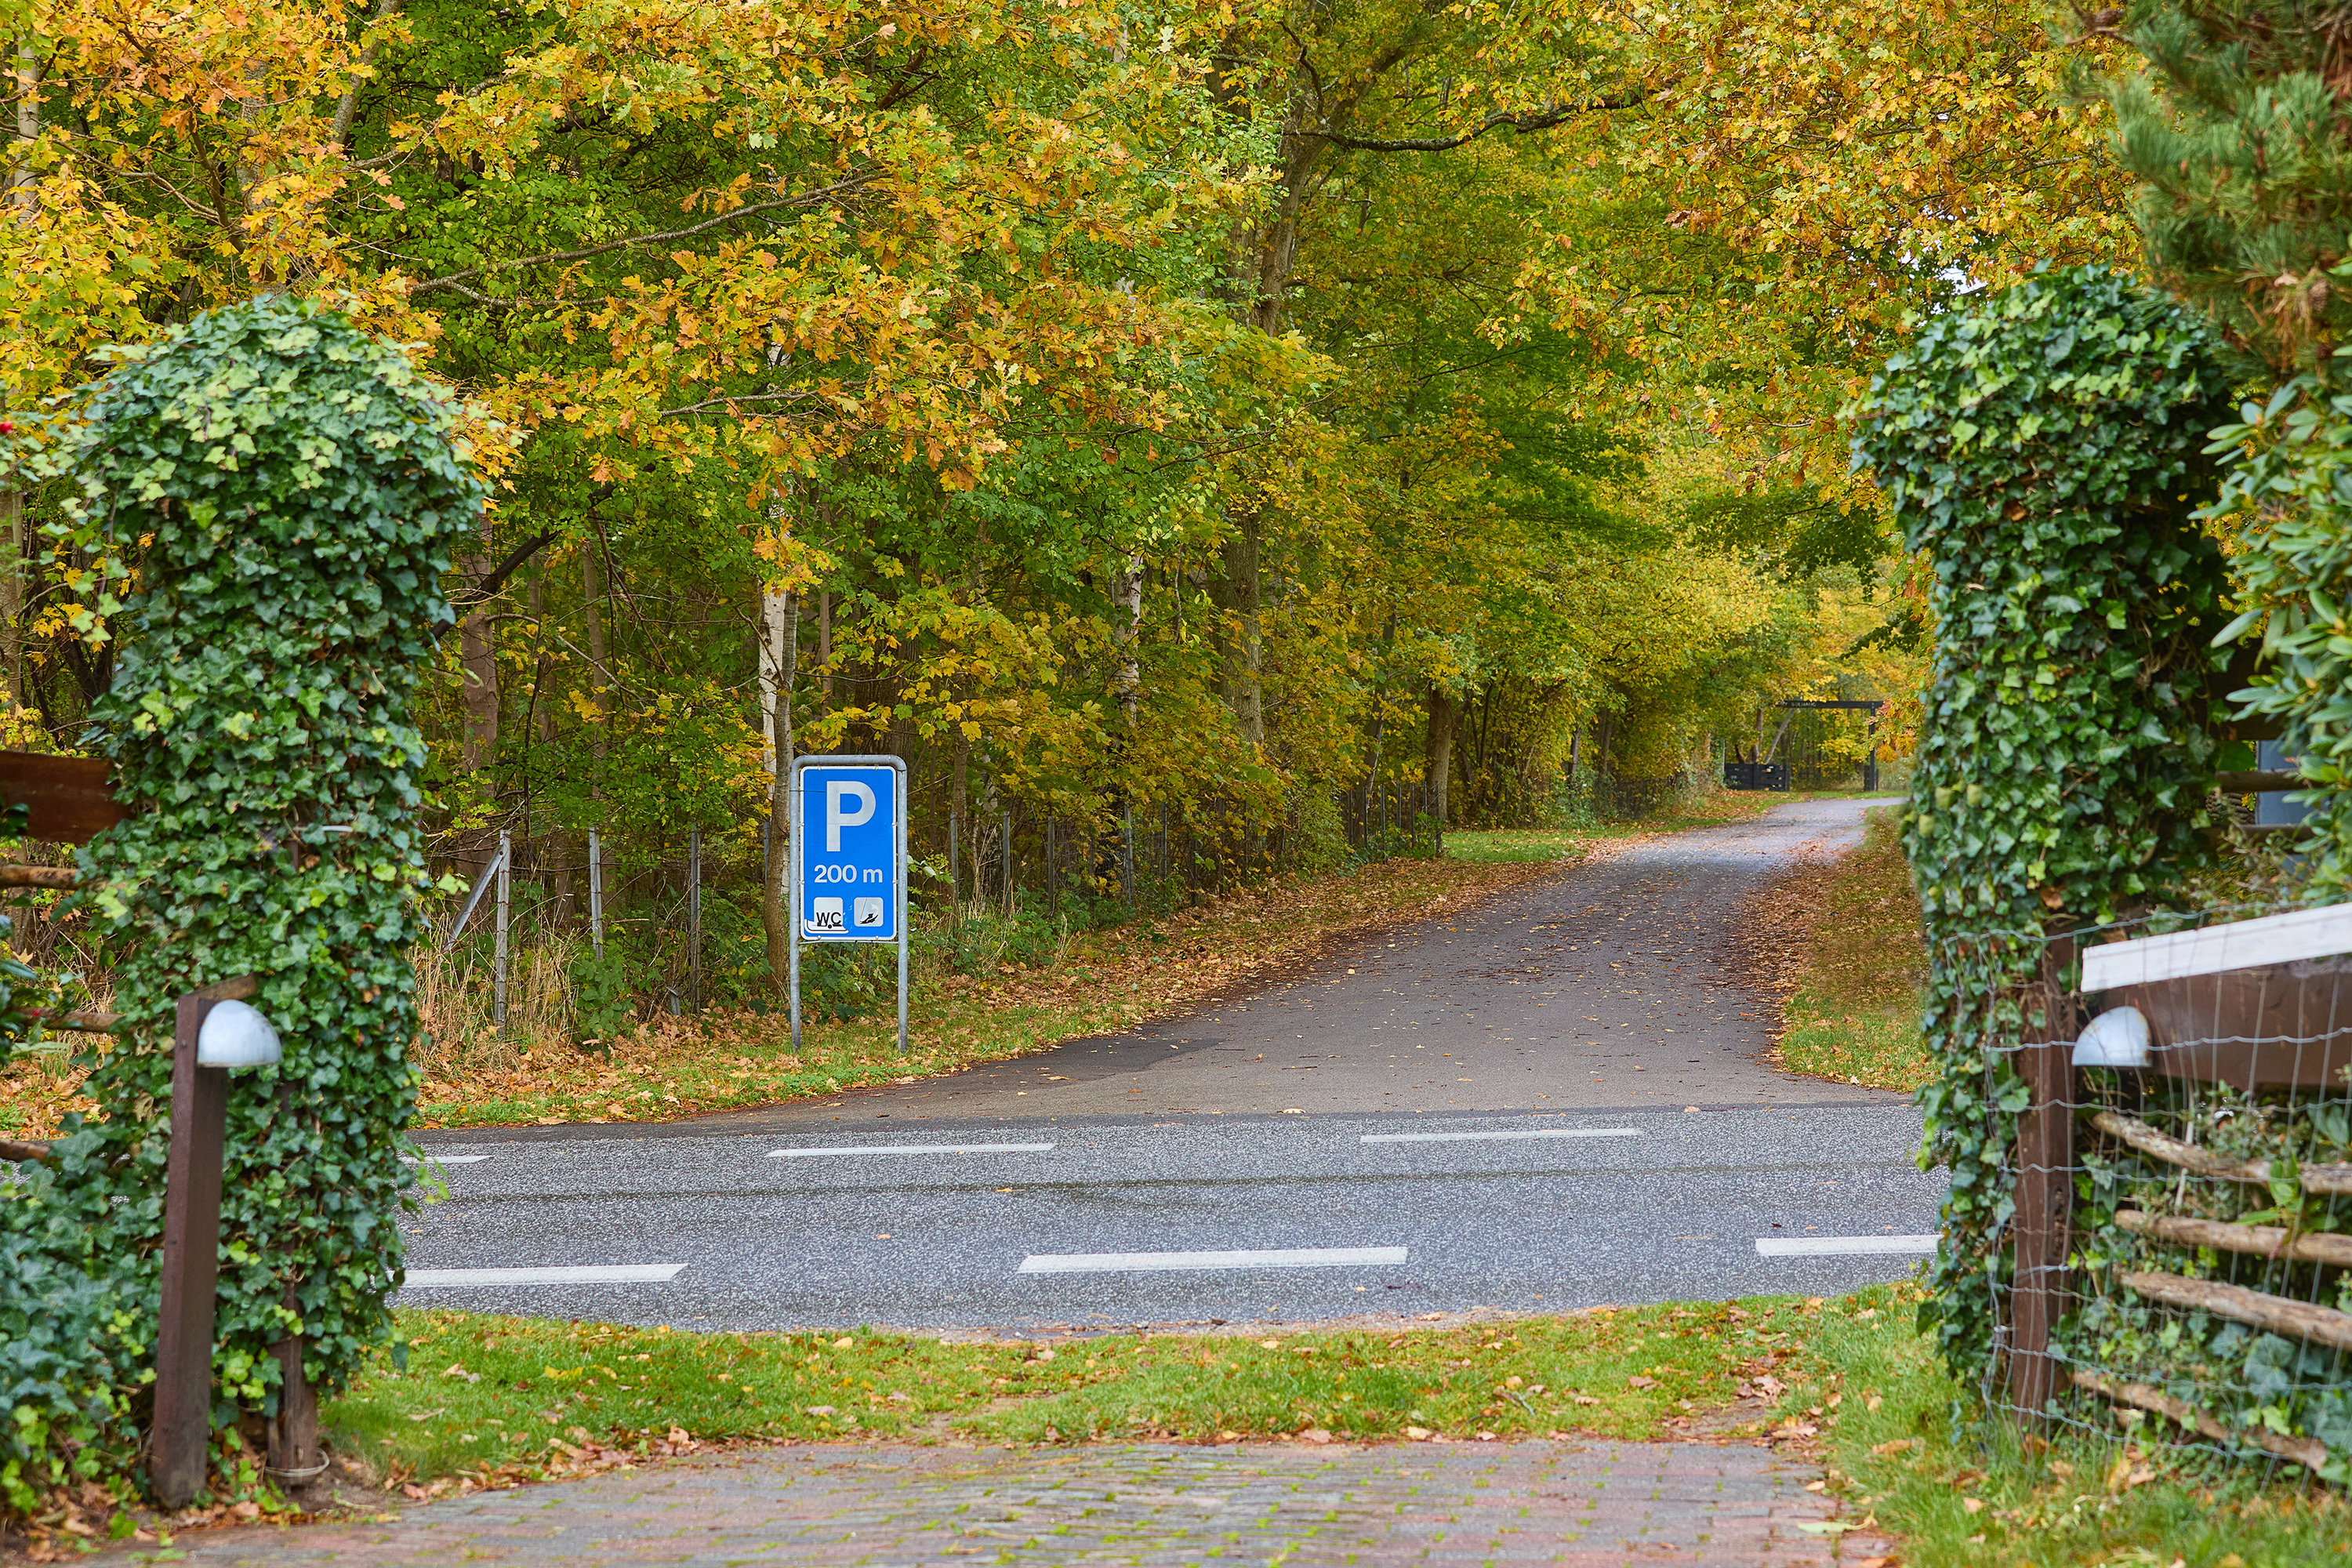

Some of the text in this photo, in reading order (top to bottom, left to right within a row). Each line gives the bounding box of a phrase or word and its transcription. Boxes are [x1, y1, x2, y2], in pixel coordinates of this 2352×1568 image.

[826, 781, 876, 851] P
[815, 865, 883, 883] 200 m
[816, 912, 842, 926] WC
